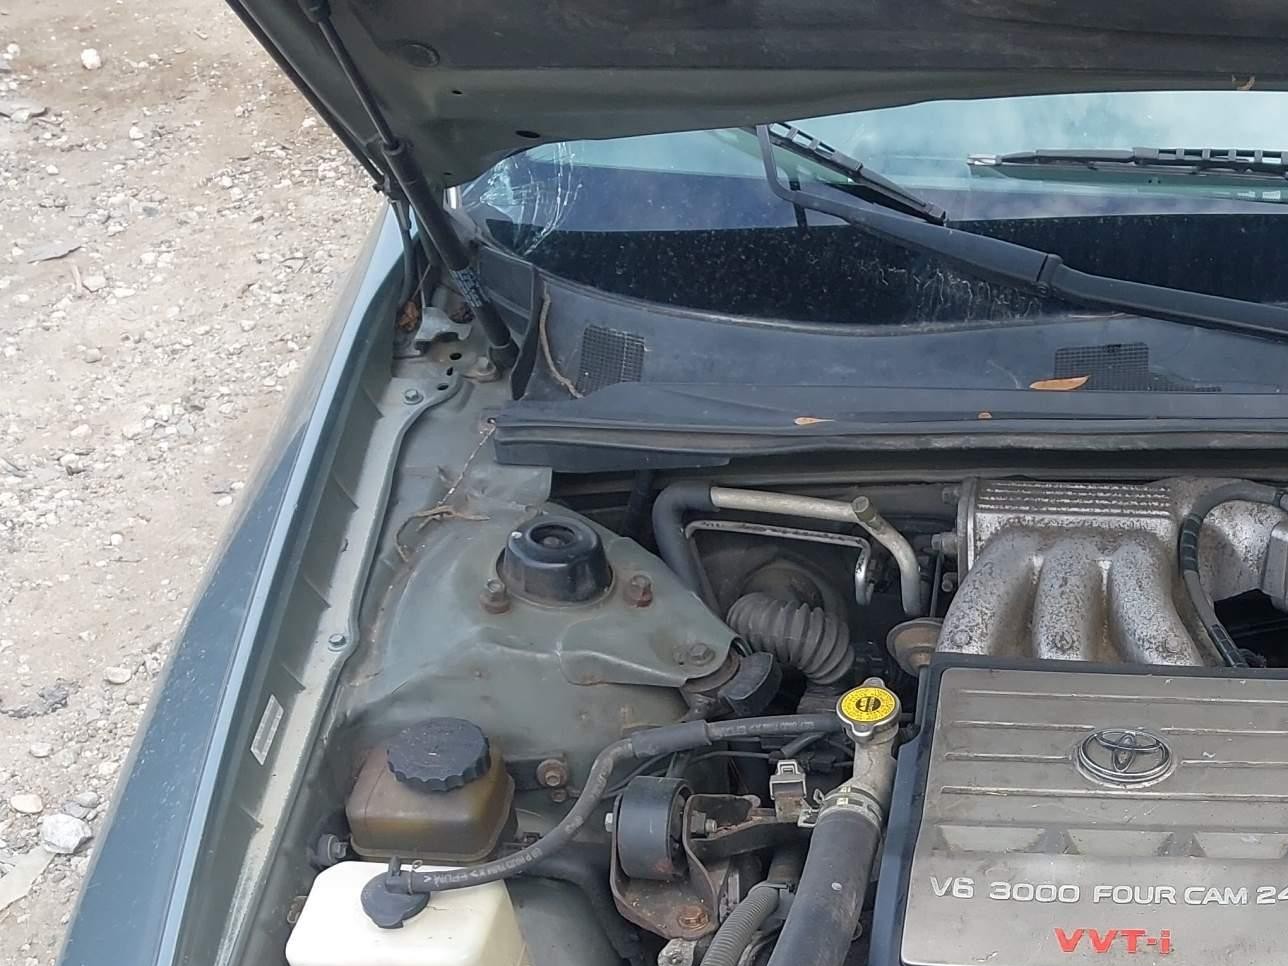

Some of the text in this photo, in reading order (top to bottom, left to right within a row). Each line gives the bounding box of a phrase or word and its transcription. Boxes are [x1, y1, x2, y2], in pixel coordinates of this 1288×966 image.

[929, 876, 976, 899] V6
[988, 880, 1080, 903] 3000
[1093, 885, 1177, 905] FOUR
[1184, 886, 1249, 905] CAM
[1054, 927, 1174, 955] VVT-i
